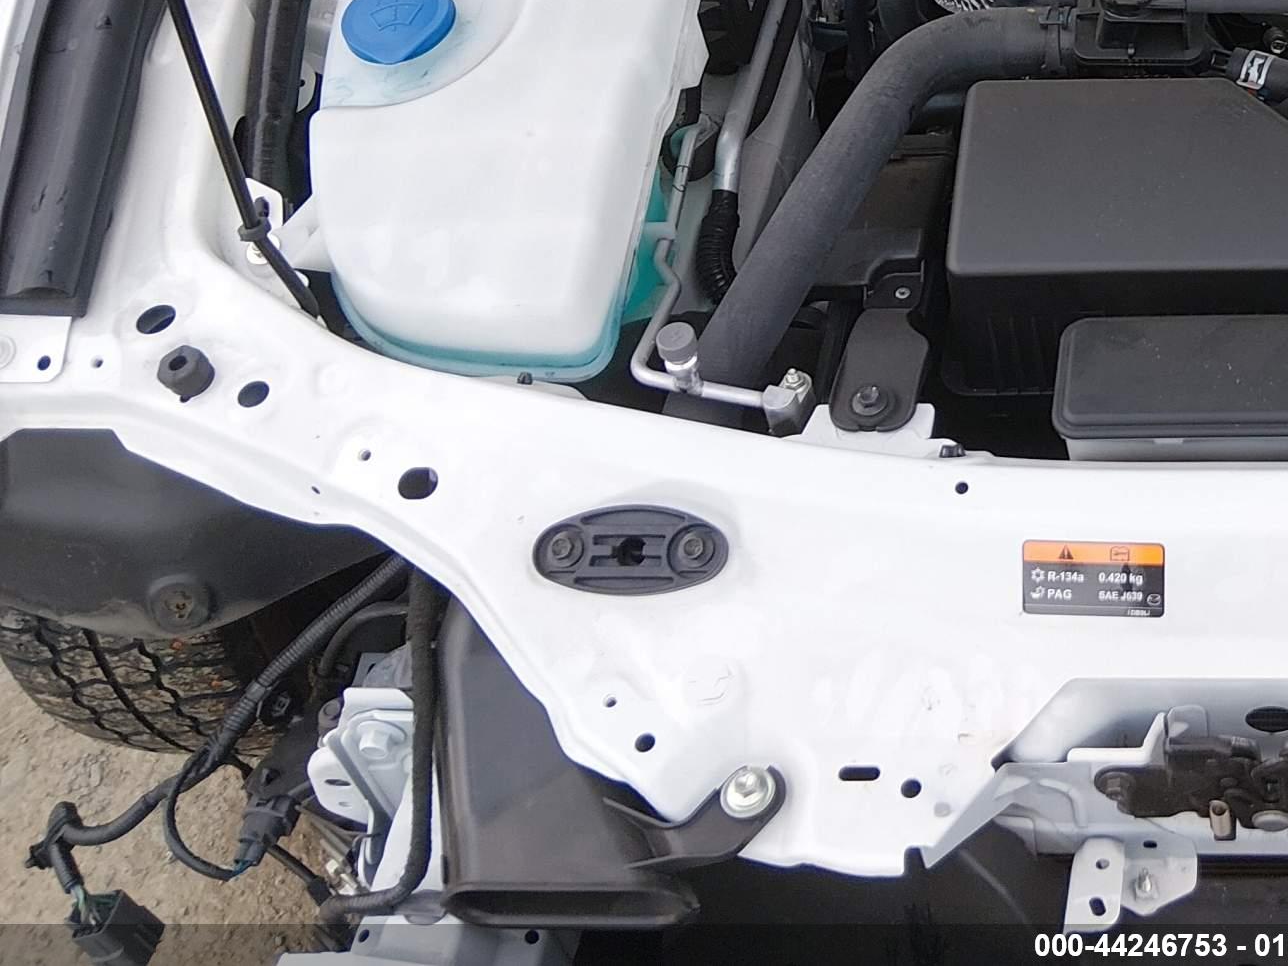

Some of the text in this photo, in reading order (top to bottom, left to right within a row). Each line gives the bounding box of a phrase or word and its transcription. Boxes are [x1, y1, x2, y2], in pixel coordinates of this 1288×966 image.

[1047, 571, 1144, 586] R-134a 0.420 kg
[1047, 589, 1073, 600] PAG
[1098, 591, 1119, 601] SAE
